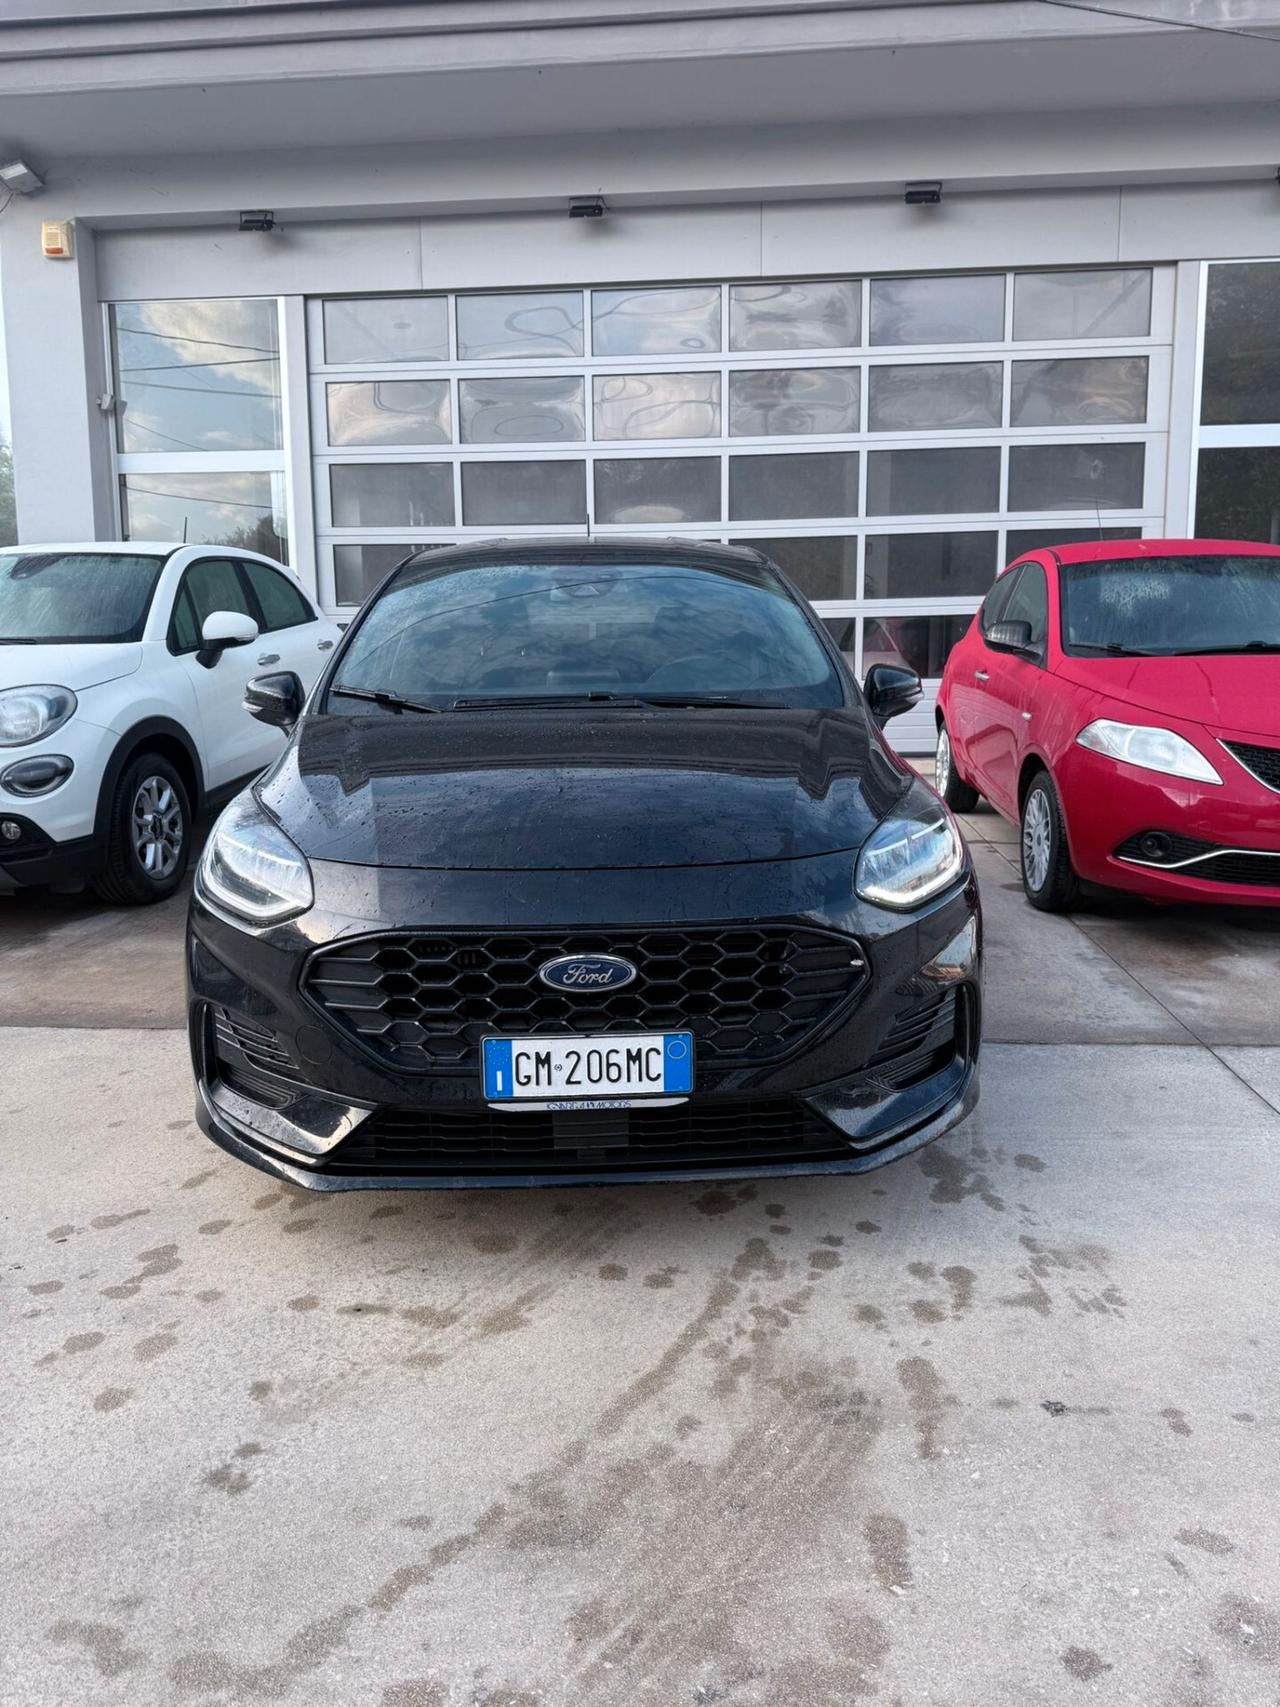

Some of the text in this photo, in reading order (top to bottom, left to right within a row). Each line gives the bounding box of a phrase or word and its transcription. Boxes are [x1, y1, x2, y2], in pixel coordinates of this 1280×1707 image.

[563, 963, 613, 984] Ford
[515, 1048, 662, 1086] GM 206MC
